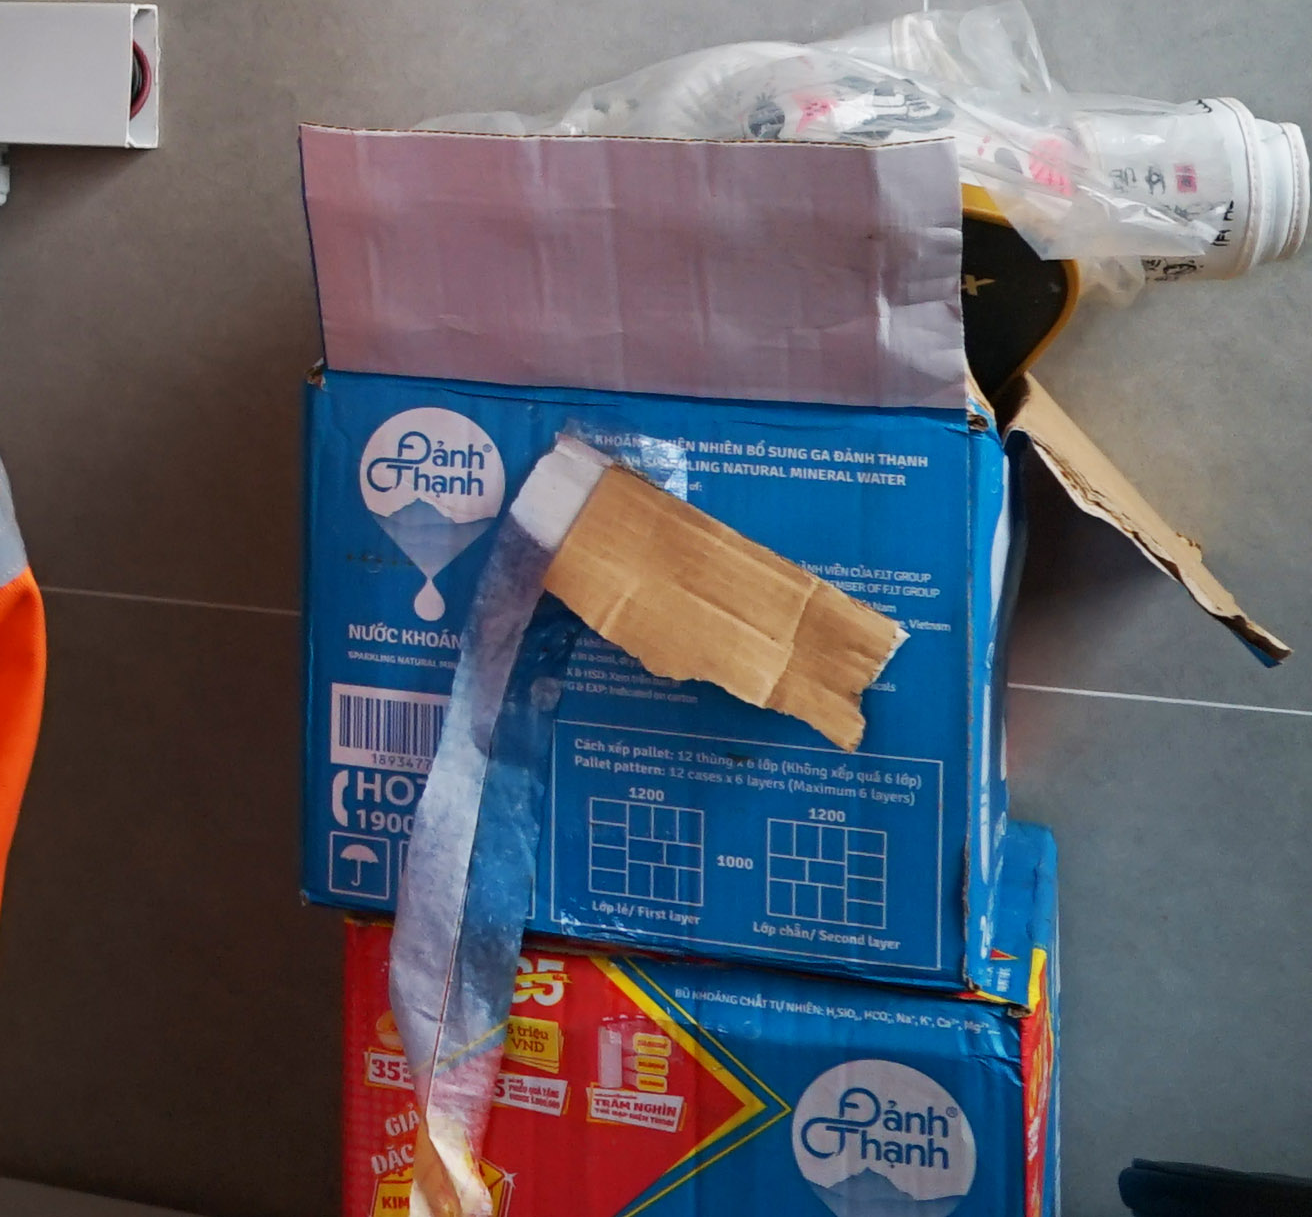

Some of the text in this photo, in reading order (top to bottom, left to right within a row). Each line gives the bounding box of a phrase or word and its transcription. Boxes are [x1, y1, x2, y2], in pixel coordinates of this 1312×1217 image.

[595, 433, 652, 448] KHOÁN
[698, 439, 743, 456] NHIÊN
[746, 440, 765, 457] BỔ
[768, 446, 808, 460] SUNG
[811, 449, 831, 462] GA
[833, 447, 875, 465] ĐẢNH
[878, 453, 928, 470] THẠNH
[723, 460, 786, 478] NATURAL
[789, 467, 854, 483] MINERAL
[857, 471, 907, 486] WATER
[825, 563, 850, 577] VIÊN
[894, 571, 932, 583] GROUP
[829, 581, 866, 593] EMBER
[867, 584, 882, 594] OF
[903, 587, 941, 599] GROUP
[348, 622, 398, 644] NƯỚC
[347, 650, 396, 665] SPARKLING
[397, 655, 437, 668] NATURAL
[574, 738, 606, 752] Cách
[608, 740, 630, 756] xếp
[633, 746, 674, 761] pallet:
[678, 751, 693, 762] 12
[696, 752, 733, 769] thùng
[747, 758, 755, 769] 6
[758, 758, 778, 773] lớp
[782, 761, 827, 780] (Không
[831, 764, 854, 782] xếp
[856, 770, 881, 784] quá
[884, 773, 893, 783] 6
[896, 774, 922, 790] lớp)
[574, 755, 611, 770] Pallet
[614, 762, 666, 776] pattern:
[669, 767, 684, 779] 12
[687, 771, 723, 783] cases
[735, 774, 743, 784] 6
[747, 775, 785, 791] layers
[788, 778, 857, 797] (Maximum
[859, 788, 867, 799] 6
[871, 788, 916, 806] layers)
[628, 787, 665, 802] 1200
[808, 808, 846, 823] 1200
[716, 854, 754, 870] 1000
[591, 899, 614, 915] Lớp
[637, 905, 667, 921] First
[669, 911, 702, 926] layer
[753, 921, 777, 937] Lớp
[819, 930, 866, 946] Second
[867, 937, 902, 951] layer
[692, 990, 738, 1005] KHOÁNG
[739, 993, 768, 1008] CHẤT
[769, 999, 785, 1012] TỰ
[786, 1001, 824, 1016] NHIÊN:
[517, 1025, 549, 1040] triệu
[512, 1038, 545, 1053] VND
[371, 1059, 401, 1081] 35
[633, 1101, 677, 1117] NGHÌN
[382, 1196, 410, 1209] KIM
